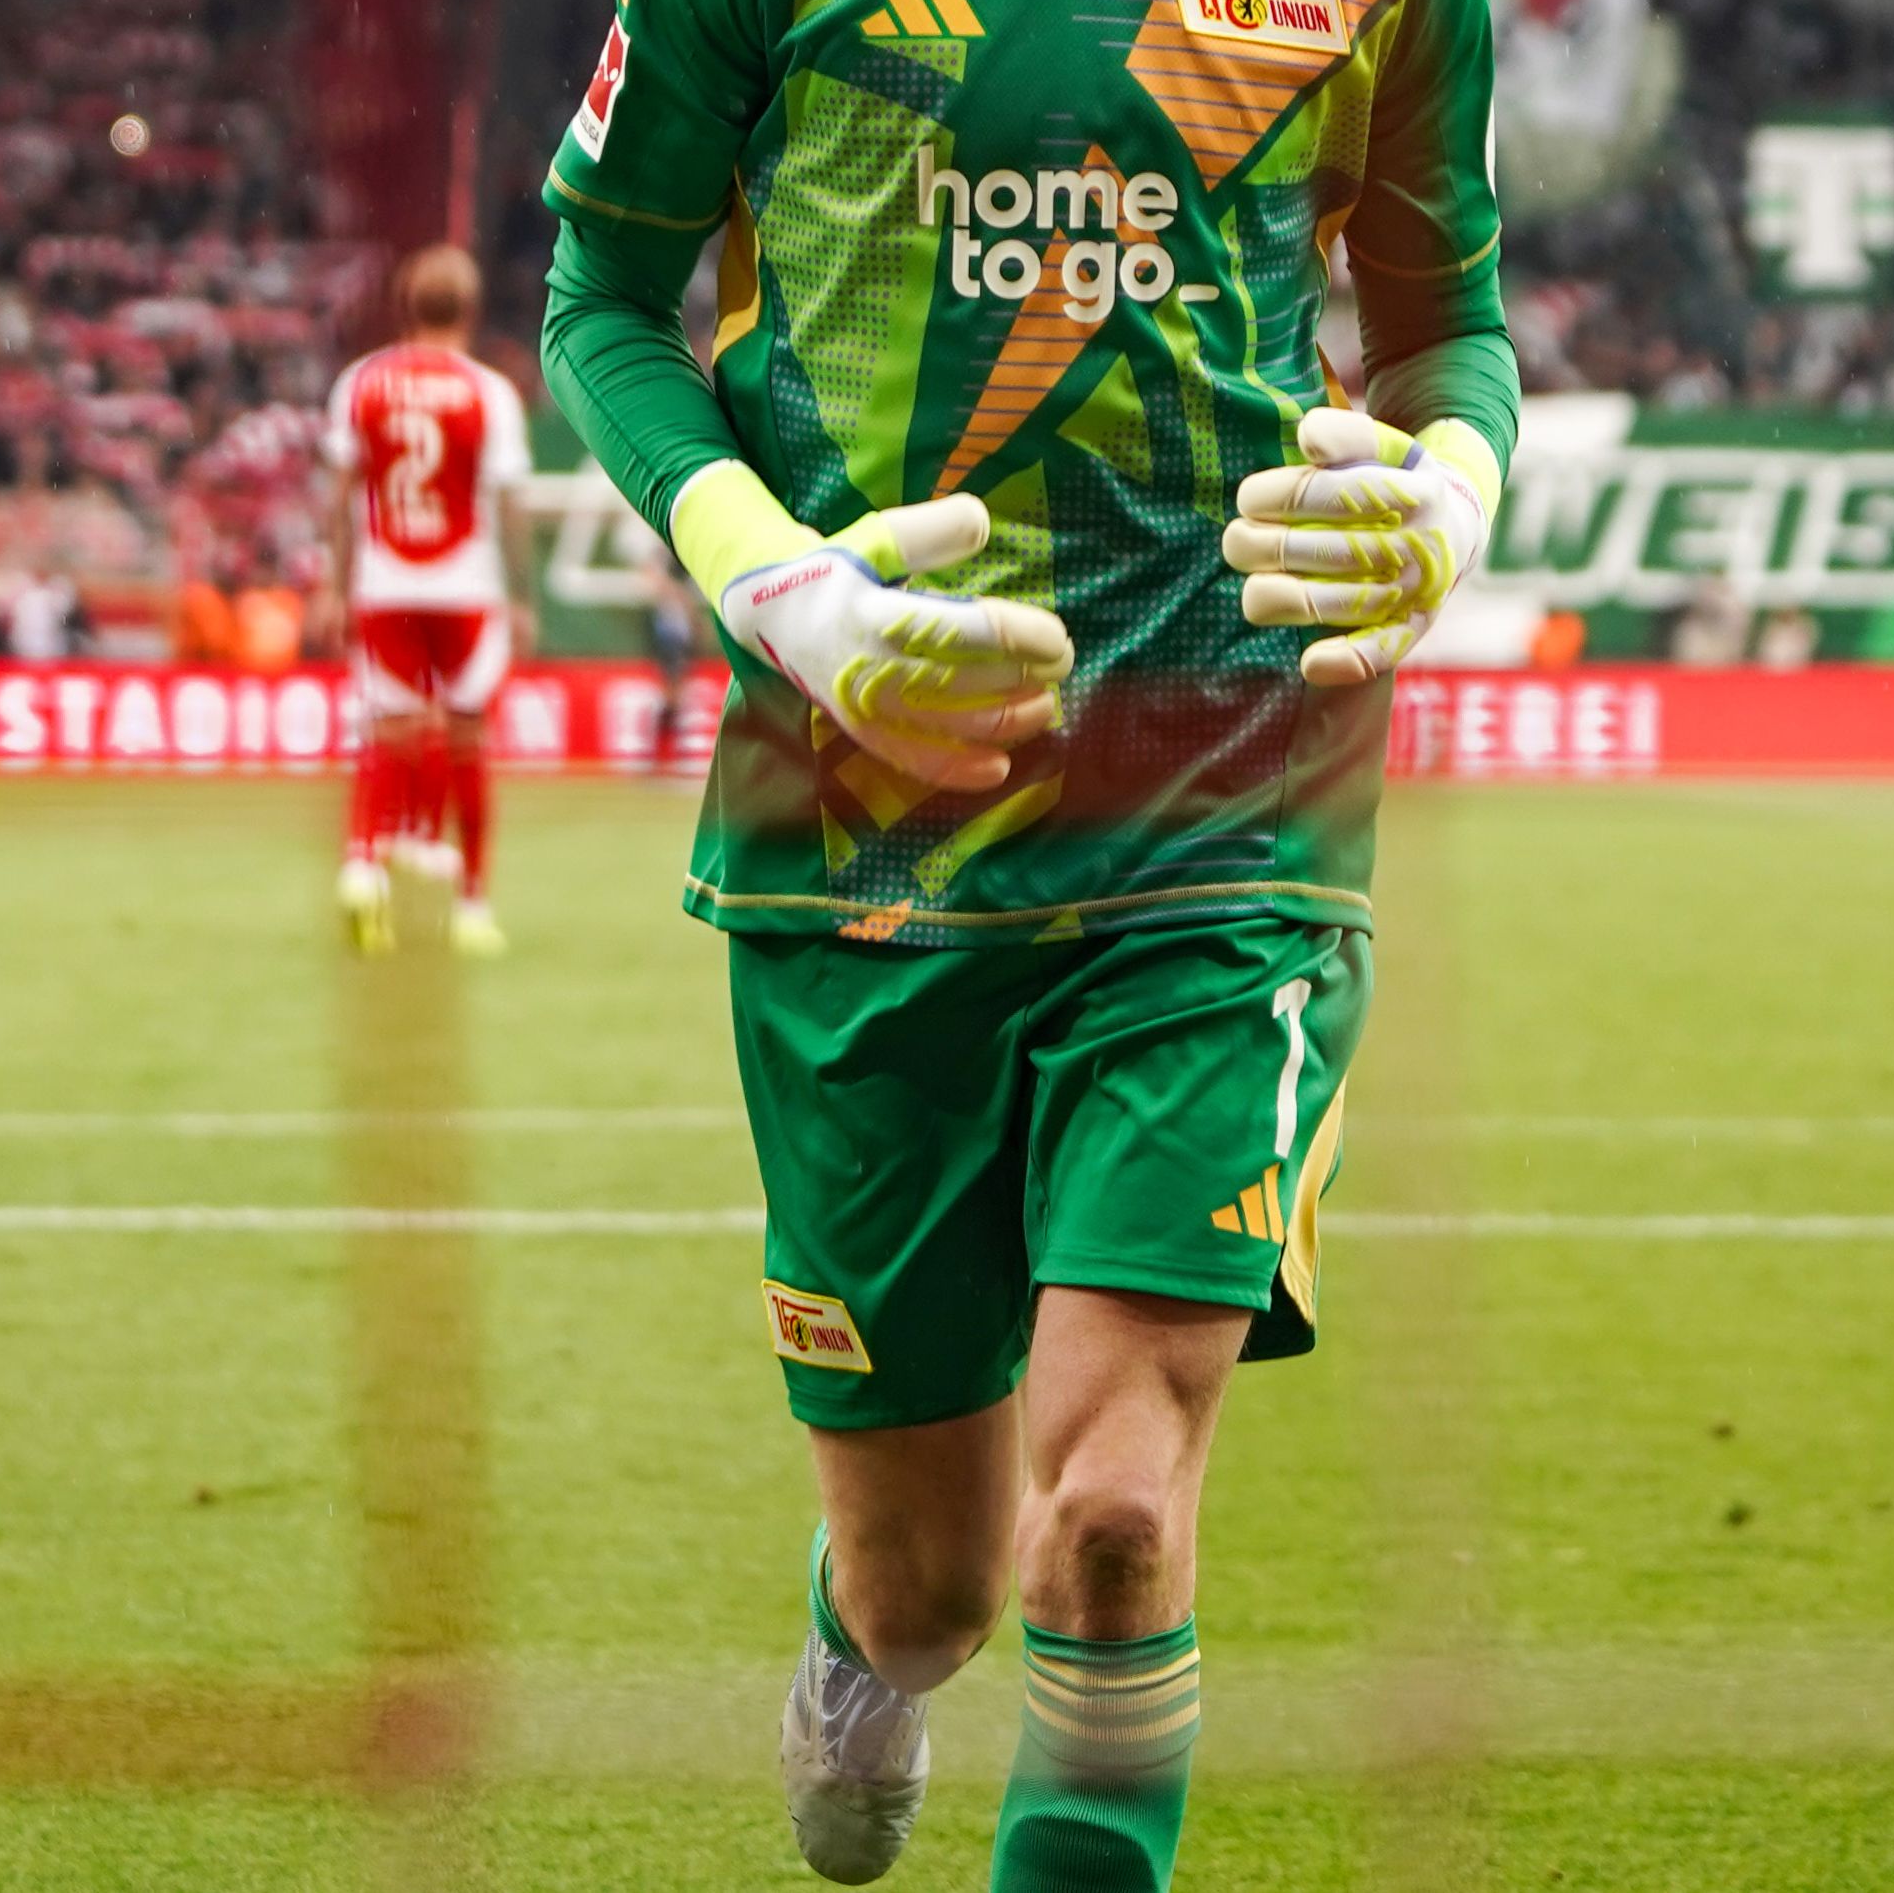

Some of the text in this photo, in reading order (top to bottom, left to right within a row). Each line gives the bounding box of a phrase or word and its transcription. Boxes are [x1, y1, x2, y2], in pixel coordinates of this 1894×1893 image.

[918, 143, 1179, 232] home
[952, 228, 1042, 300] to
[750, 561, 833, 607] PREDATOR
[1271, 976, 1313, 1160] 1
